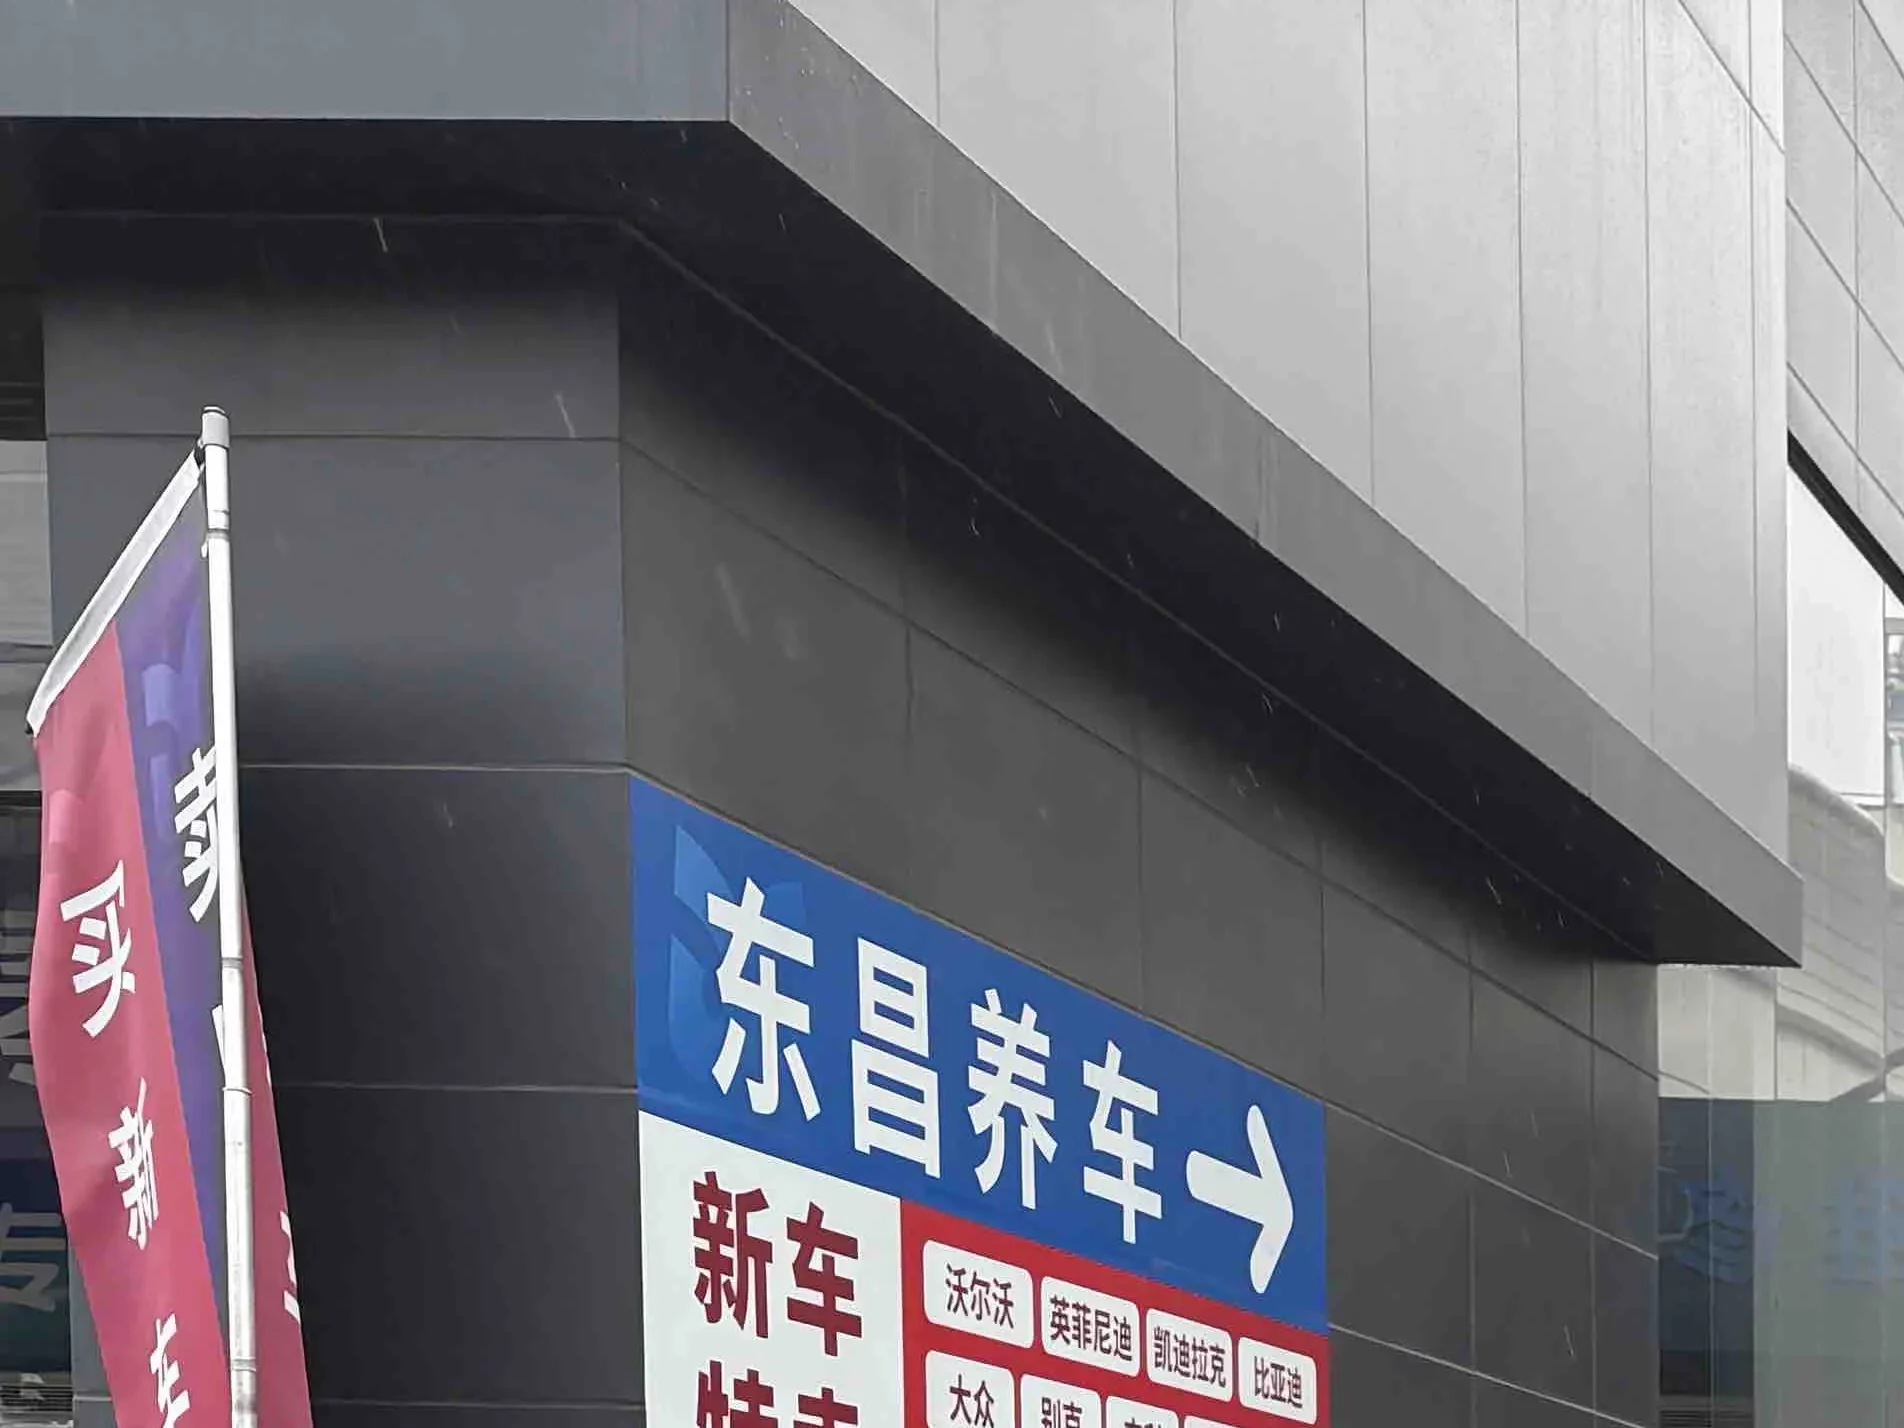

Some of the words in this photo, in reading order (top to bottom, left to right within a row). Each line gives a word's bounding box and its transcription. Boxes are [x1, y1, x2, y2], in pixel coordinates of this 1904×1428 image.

[707, 877, 1163, 1244] 东昌养车
[692, 1170, 862, 1357] 新车
[945, 1264, 1014, 1329] 沃尔沃
[1050, 1294, 1133, 1362] 英菲尼迪
[1153, 1326, 1226, 1388] 凯迪拉克
[1254, 1356, 1303, 1409] 比亚迪
[949, 1374, 995, 1428] 大众
